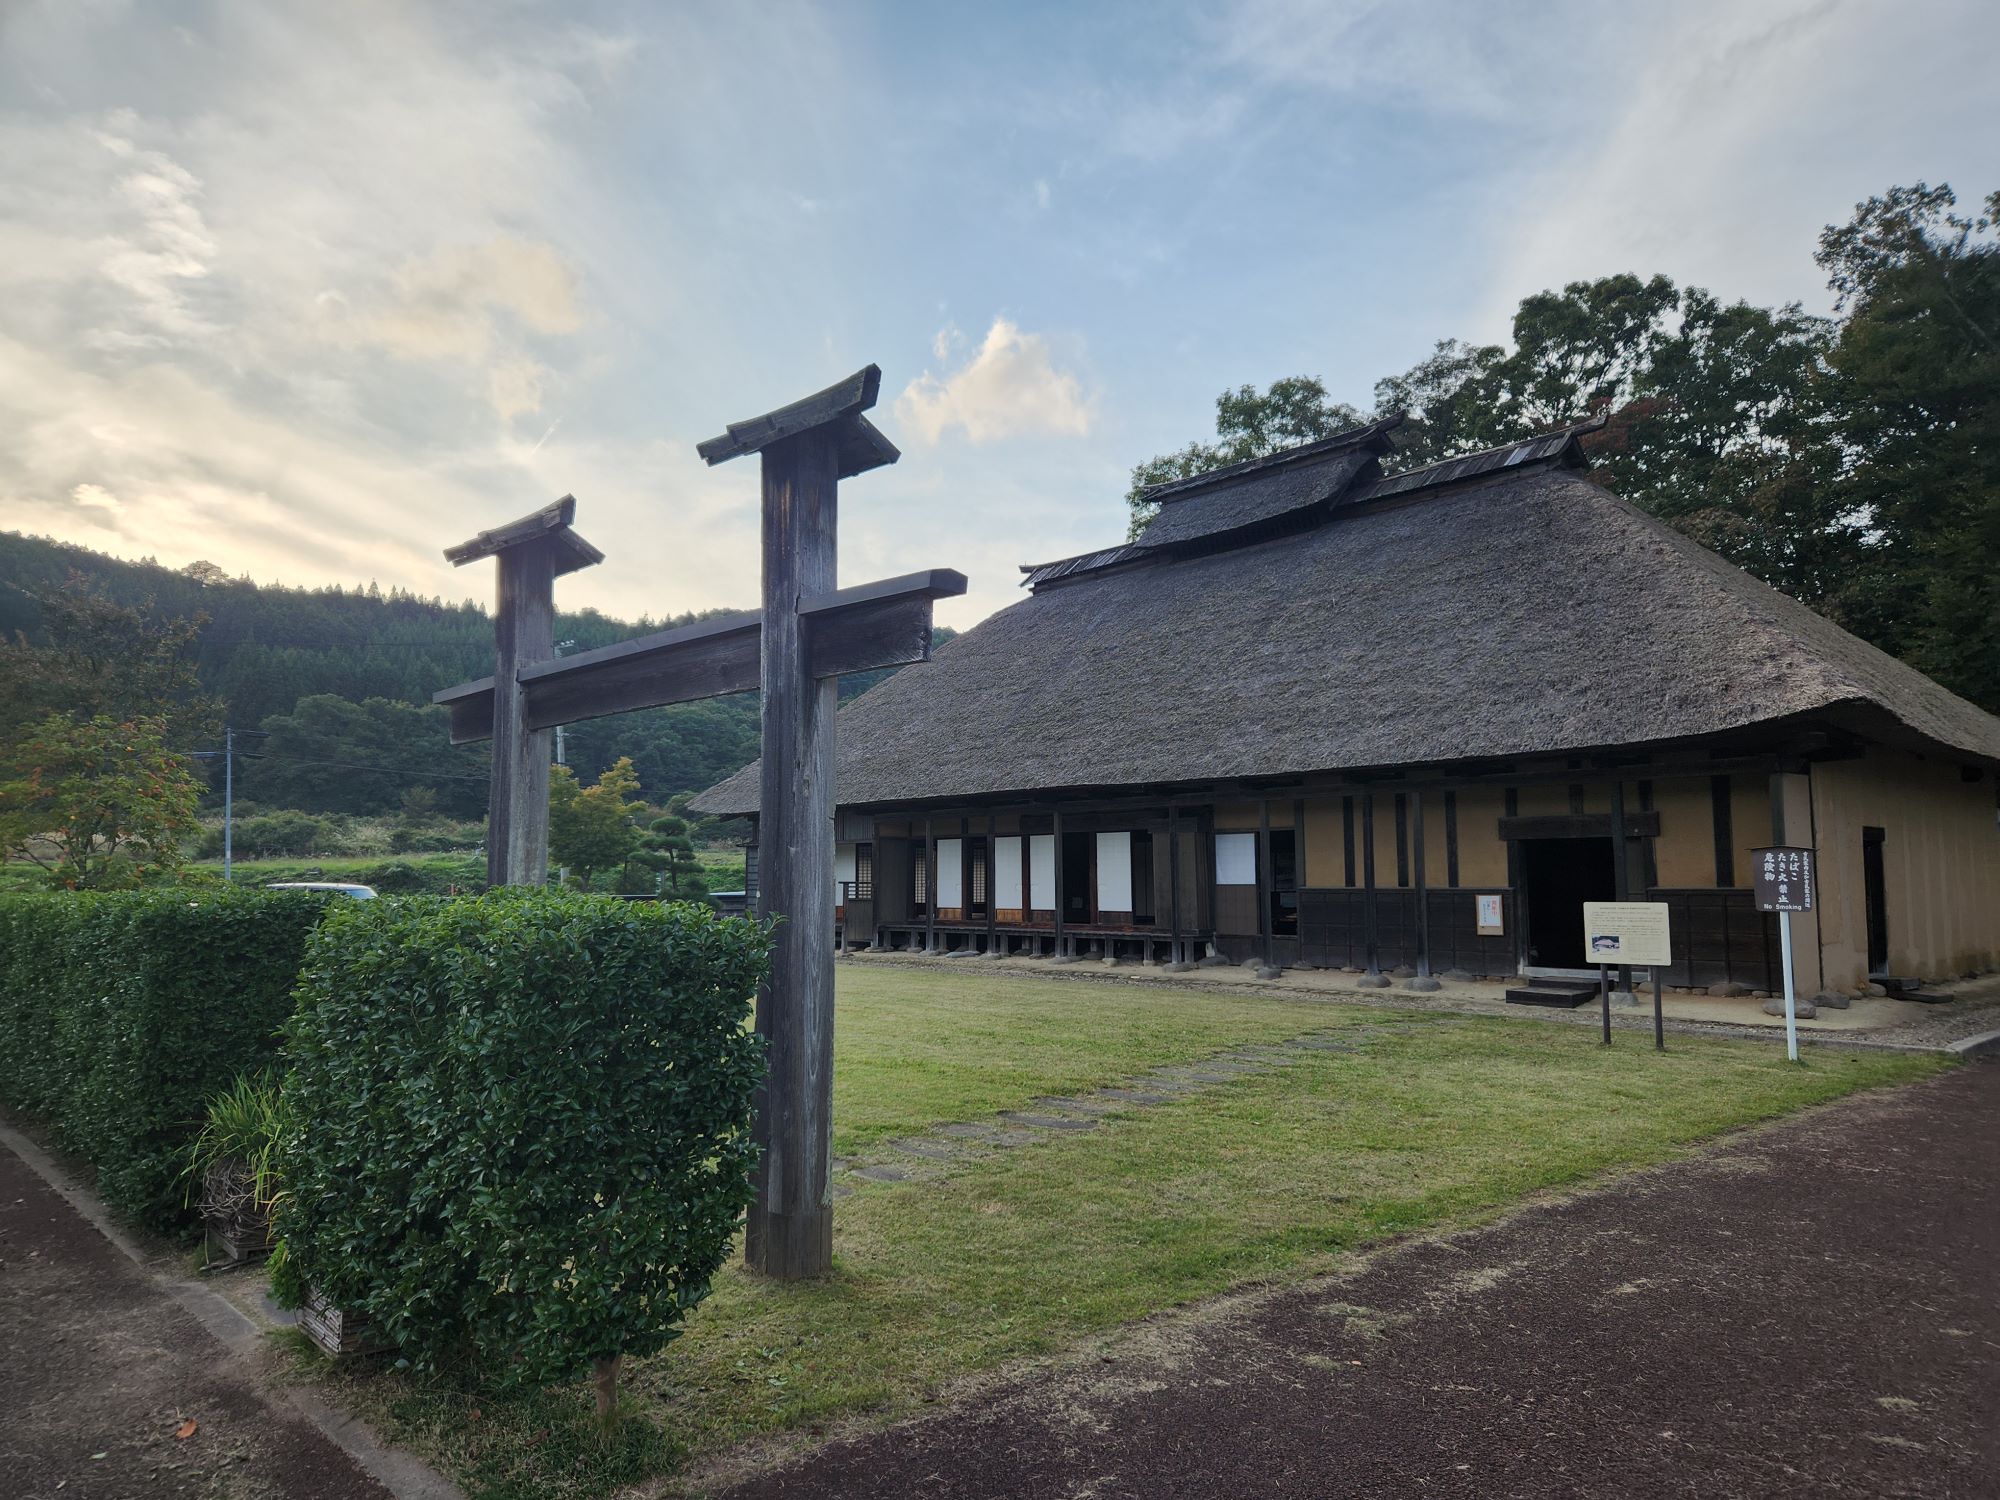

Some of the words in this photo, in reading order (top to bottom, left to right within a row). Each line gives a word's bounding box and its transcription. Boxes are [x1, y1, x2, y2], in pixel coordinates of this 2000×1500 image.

[1764, 852, 1775, 881] 危険物
[1790, 852, 1800, 880] たばこ
[1776, 903, 1802, 911] Smoking
